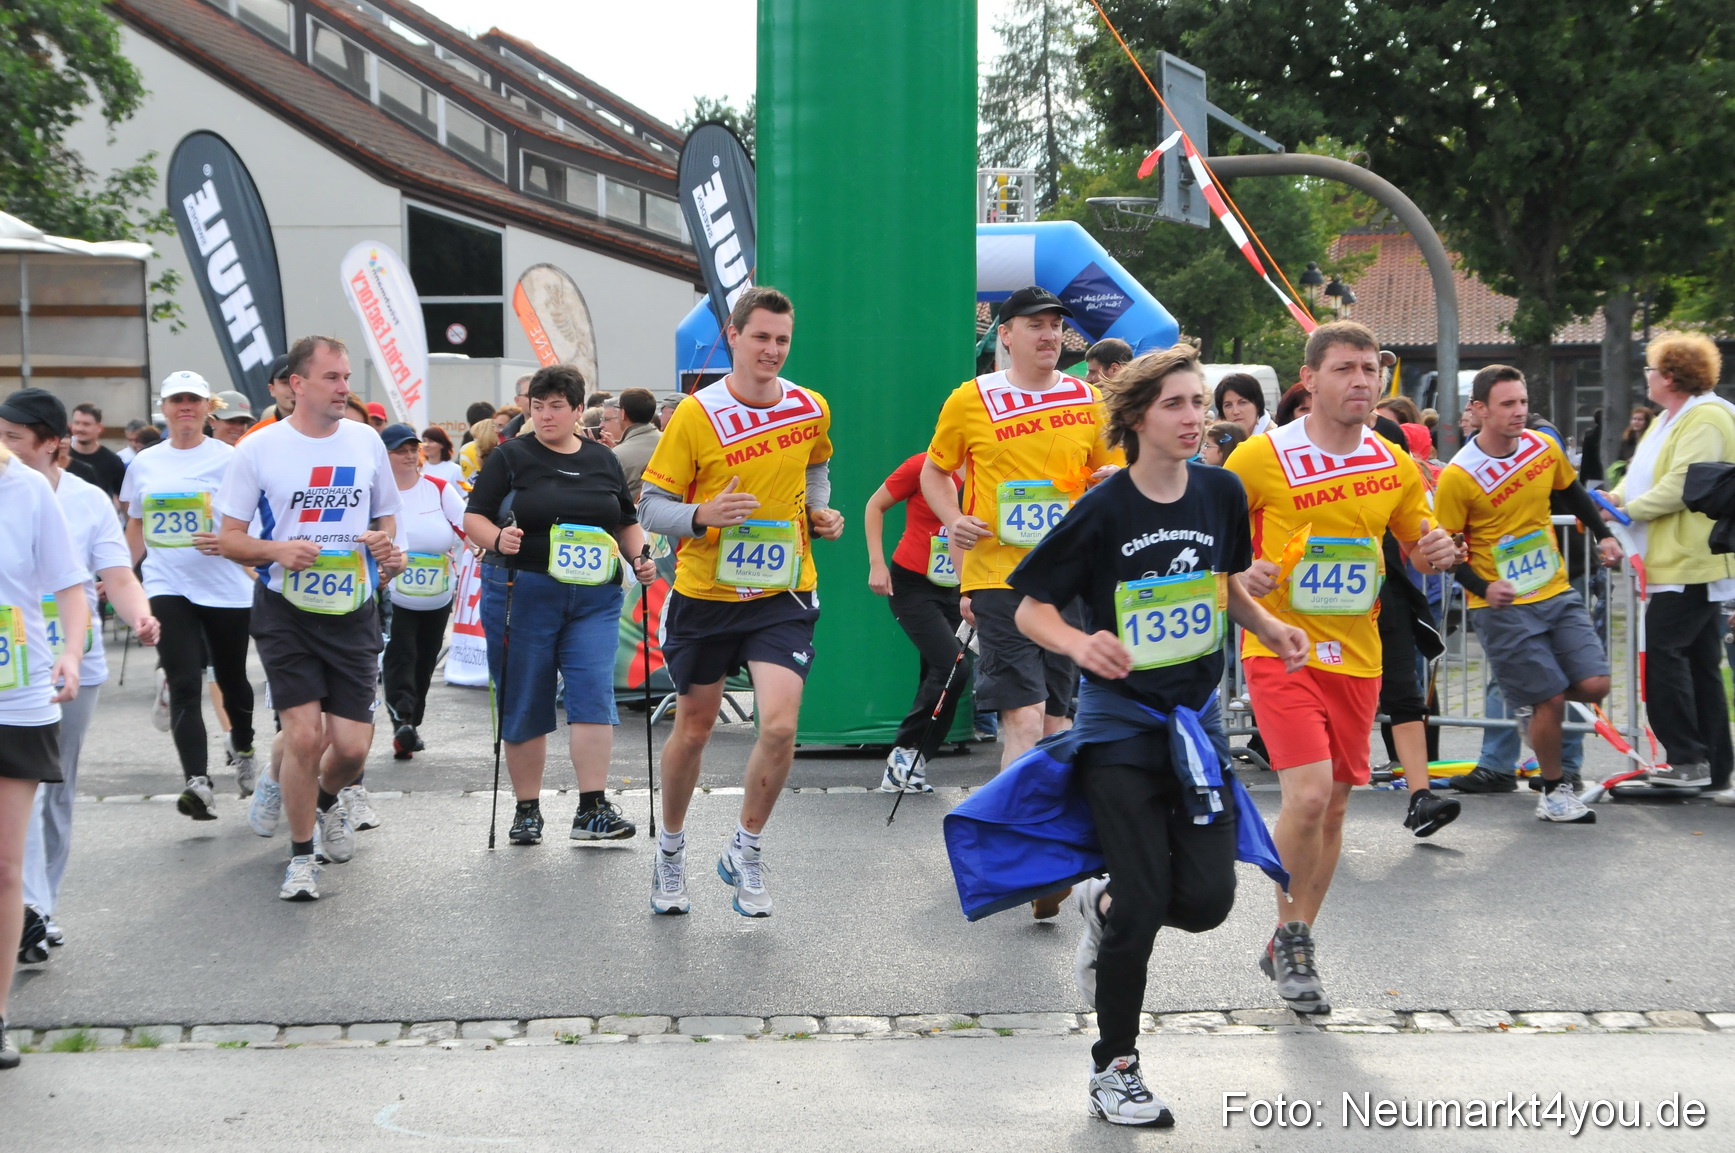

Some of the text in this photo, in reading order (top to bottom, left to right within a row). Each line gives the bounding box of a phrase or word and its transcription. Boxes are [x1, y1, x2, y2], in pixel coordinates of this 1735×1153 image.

[995, 409, 1095, 442] MAX BÖGL
[725, 424, 821, 467] MAX BÖGL
[305, 487, 353, 496] AUTOHAUS
[1292, 475, 1403, 511] MAX BÖGL
[1489, 454, 1557, 508] MAX BÖGL
[290, 488, 362, 510] PERRAS
[151, 511, 199, 534] 238
[1006, 503, 1063, 530] 436
[726, 542, 786, 571] 449
[1121, 528, 1215, 557] Chickenrun
[557, 544, 603, 570] 533
[1506, 549, 1548, 581] 444
[288, 571, 354, 597] 1264
[402, 567, 440, 585] 867
[735, 569, 760, 577] Markus
[1300, 563, 1366, 594] 445
[1311, 596, 1338, 604] Jürgen
[1125, 603, 1211, 646] 1339
